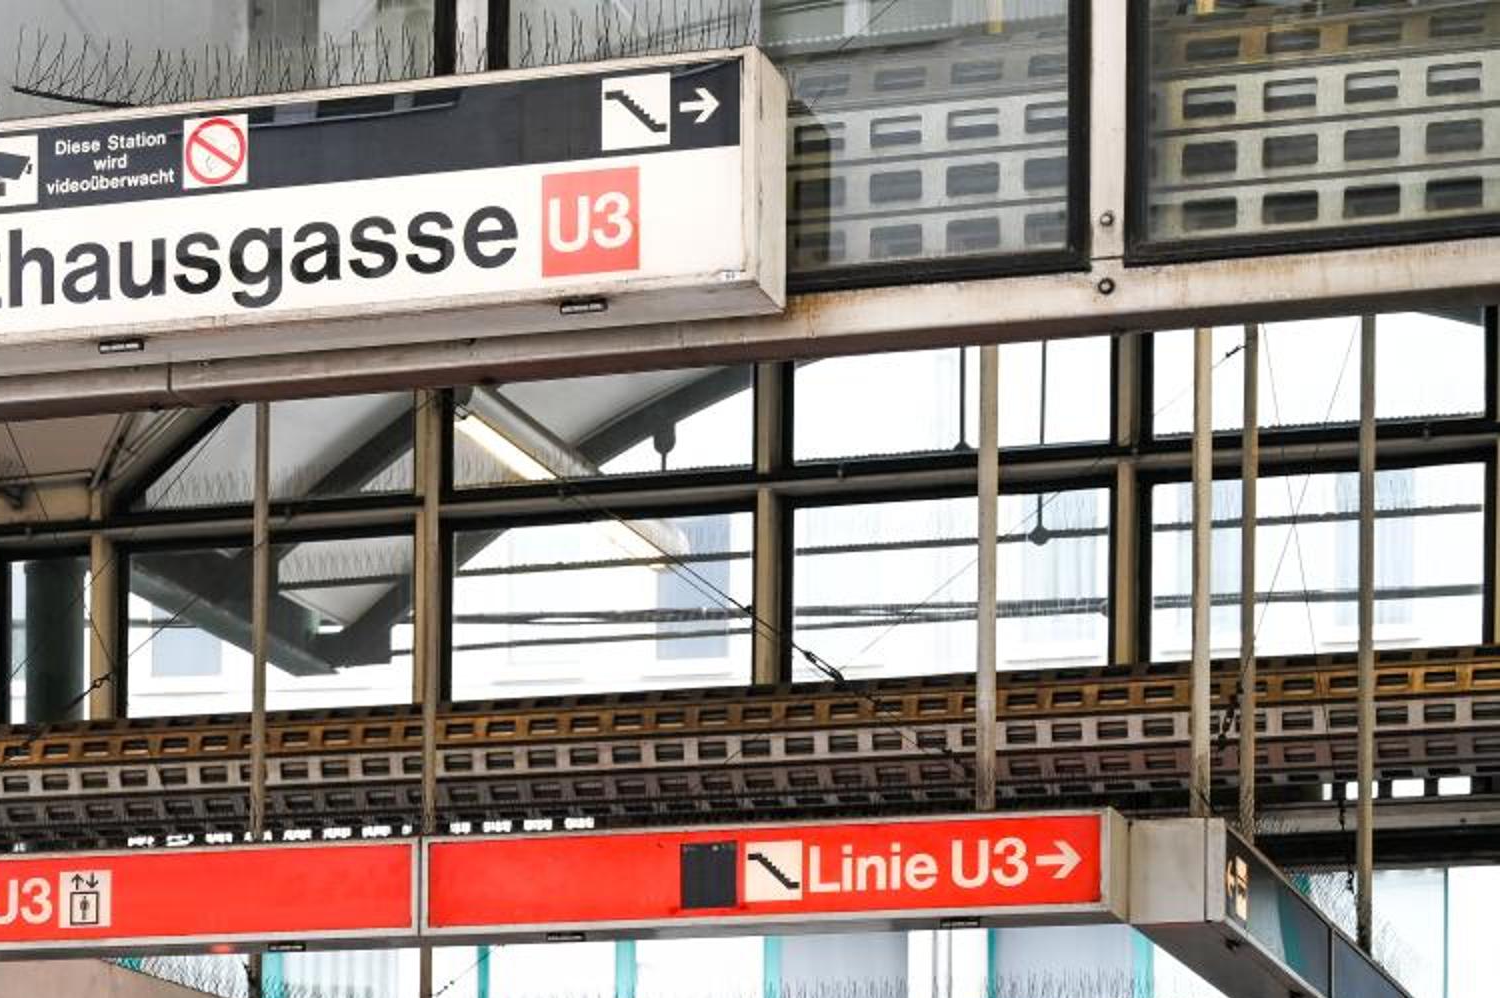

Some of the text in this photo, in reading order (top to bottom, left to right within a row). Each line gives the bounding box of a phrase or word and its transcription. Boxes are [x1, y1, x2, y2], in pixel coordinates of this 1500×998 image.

[55, 131, 167, 156] Diese Station
[94, 153, 128, 171] wird
[46, 168, 176, 195] videoüberwacht
[548, 191, 634, 253] U3
[809, 836, 1029, 893] Linie U3
